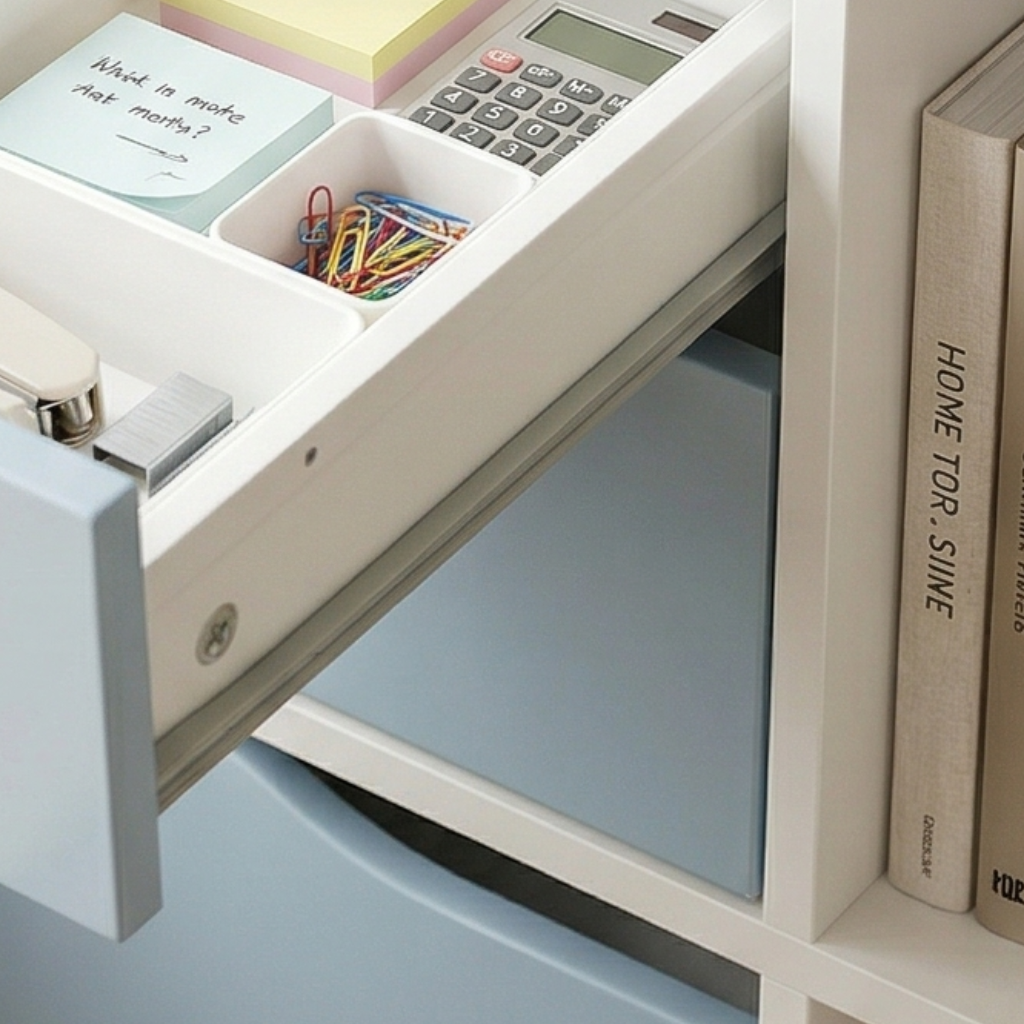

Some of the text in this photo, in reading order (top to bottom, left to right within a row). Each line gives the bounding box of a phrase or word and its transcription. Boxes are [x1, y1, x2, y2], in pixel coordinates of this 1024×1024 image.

[468, 69, 487, 81] 7
[548, 102, 569, 116] 9
[422, 110, 436, 124] 1
[458, 125, 480, 143] 2
[500, 143, 519, 158] 3
[933, 340, 967, 444] HOME
